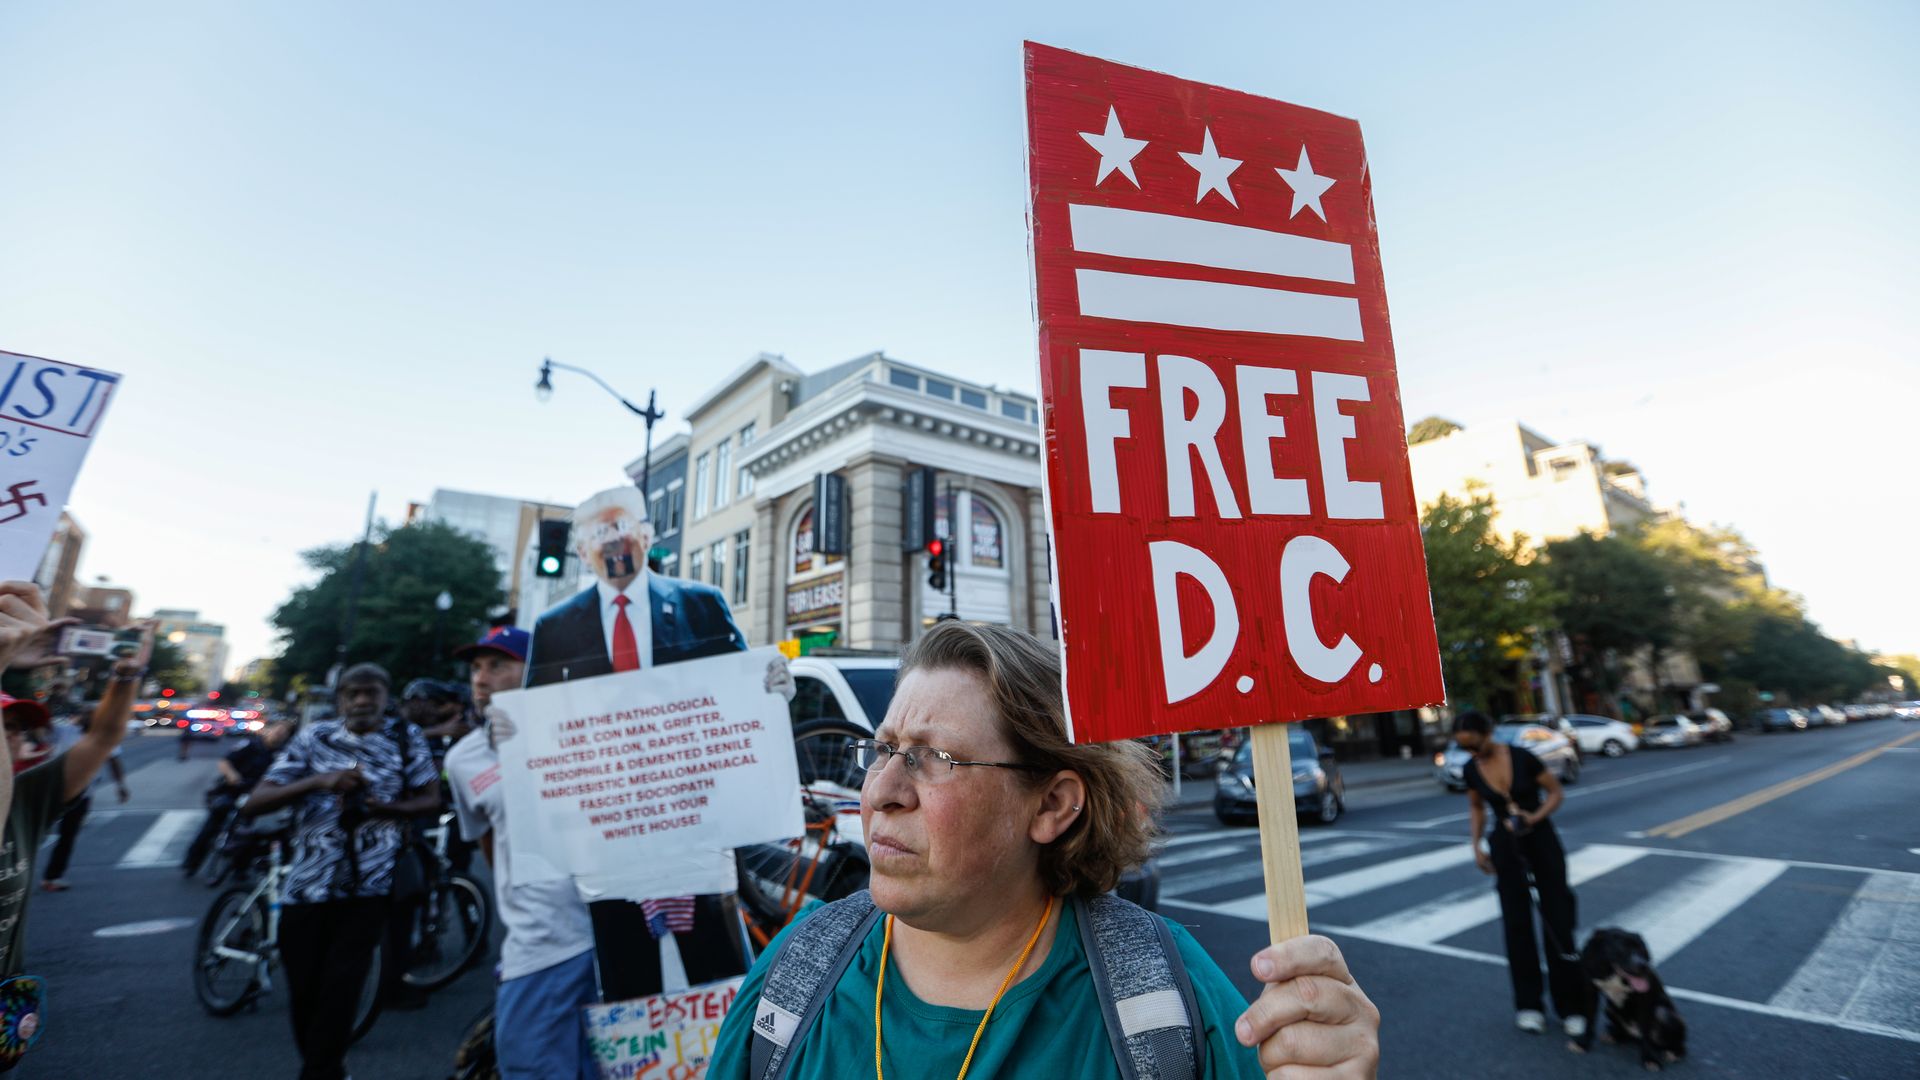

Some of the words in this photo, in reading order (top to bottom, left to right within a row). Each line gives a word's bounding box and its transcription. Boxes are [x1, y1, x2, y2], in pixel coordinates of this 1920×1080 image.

[1079, 348, 1385, 520] FREE
[788, 590, 808, 614] FOR
[808, 580, 843, 609] LEASE
[1148, 535, 1383, 704] D.C.
[566, 719, 585, 731] AM
[589, 714, 613, 727] THE
[616, 696, 718, 722] PATHOLOGICAL
[594, 730, 622, 743] CON
[663, 711, 724, 731] GRIFTER,
[526, 749, 596, 770] CONVICTED
[600, 741, 645, 757] FELON,
[648, 732, 699, 749] RAPIST,
[702, 720, 765, 740] TRAITOR,
[544, 763, 612, 783] PEDOPHILE
[616, 761, 624, 772] &
[627, 747, 702, 769] DEMENTED
[706, 738, 752, 756] SENILE
[541, 777, 626, 800] NARCISSISTIC
[629, 754, 758, 785] MEGALOMANIACAL
[580, 793, 632, 810] FASCIST
[636, 778, 715, 802] SOCIOPATH
[590, 811, 623, 825] WHO
[625, 804, 666, 820] STOLE
[671, 795, 709, 811] YOUR
[603, 823, 646, 840] WHITE
[649, 813, 701, 833] HOUSE!
[757, 1020, 776, 1035] adidas
